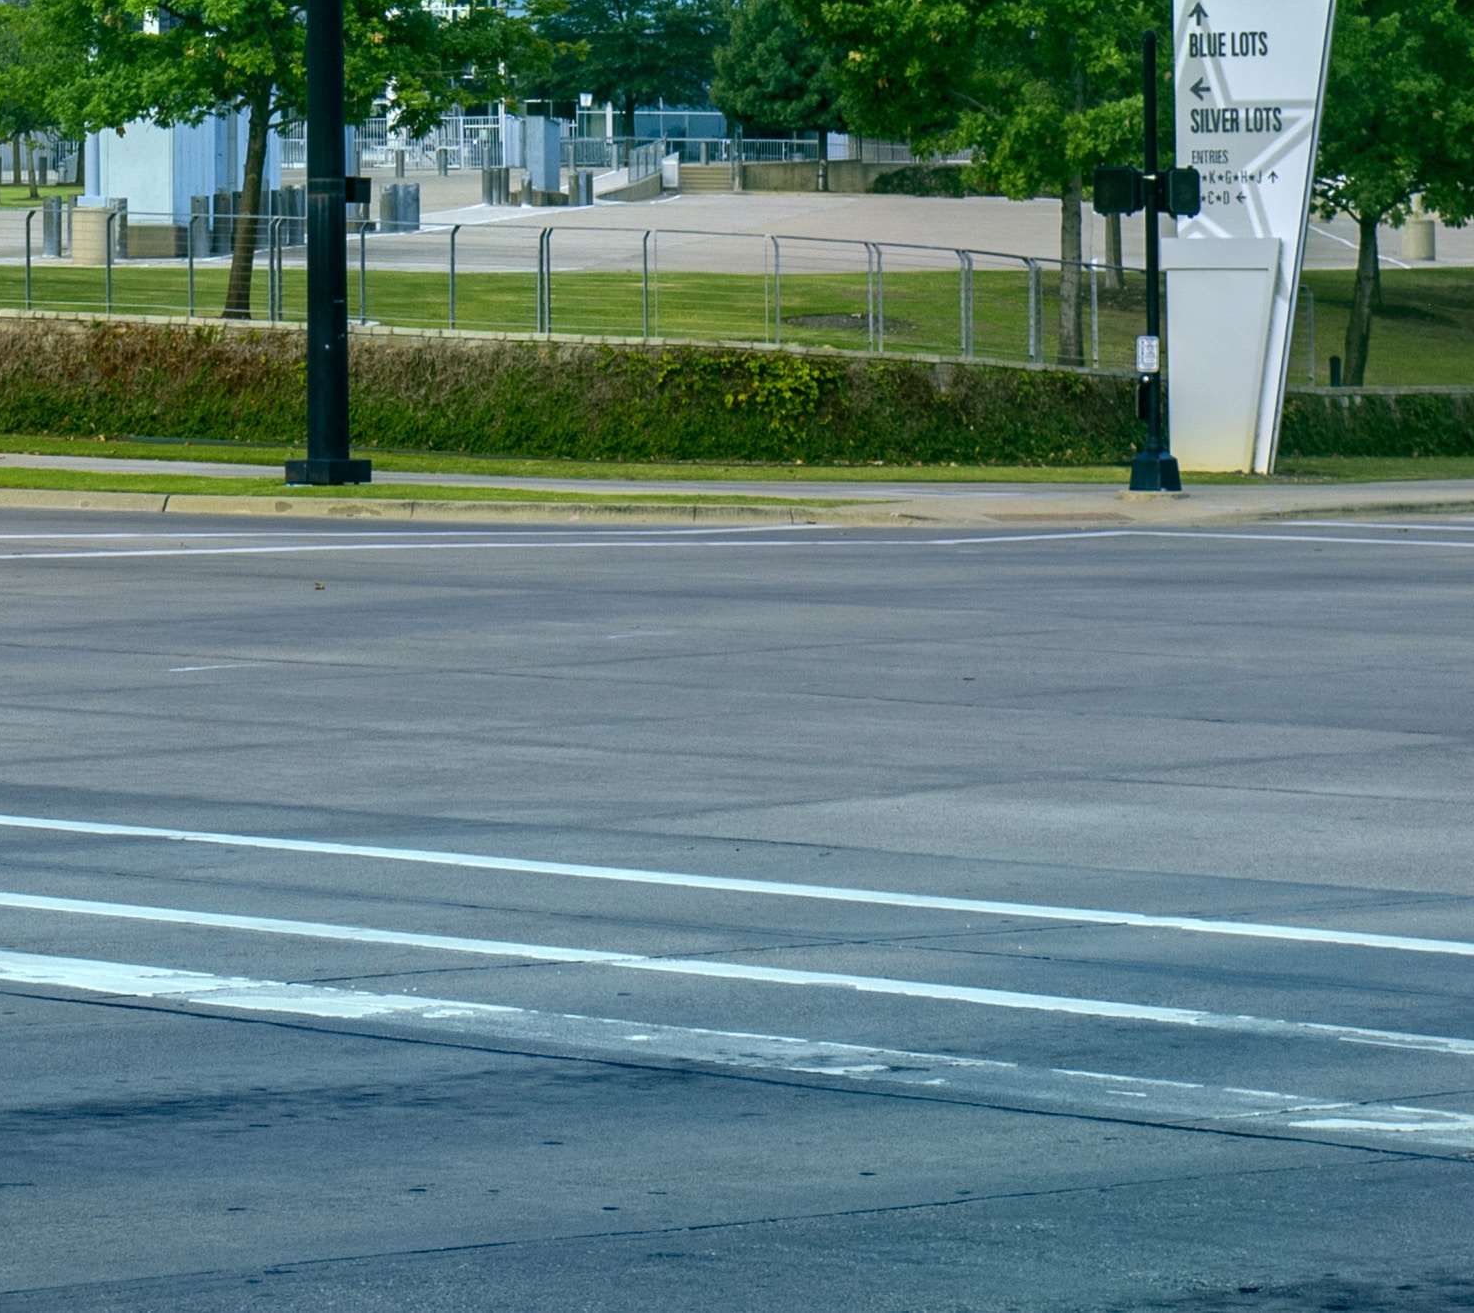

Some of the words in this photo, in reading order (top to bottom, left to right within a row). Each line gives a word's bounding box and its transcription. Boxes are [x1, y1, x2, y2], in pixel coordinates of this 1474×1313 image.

[1189, 33, 1226, 58] BLUE
[1231, 32, 1267, 56] LOTS
[1190, 108, 1239, 133] SILVER
[1246, 107, 1282, 132] LOTS
[1192, 150, 1228, 164] ENTRIES
